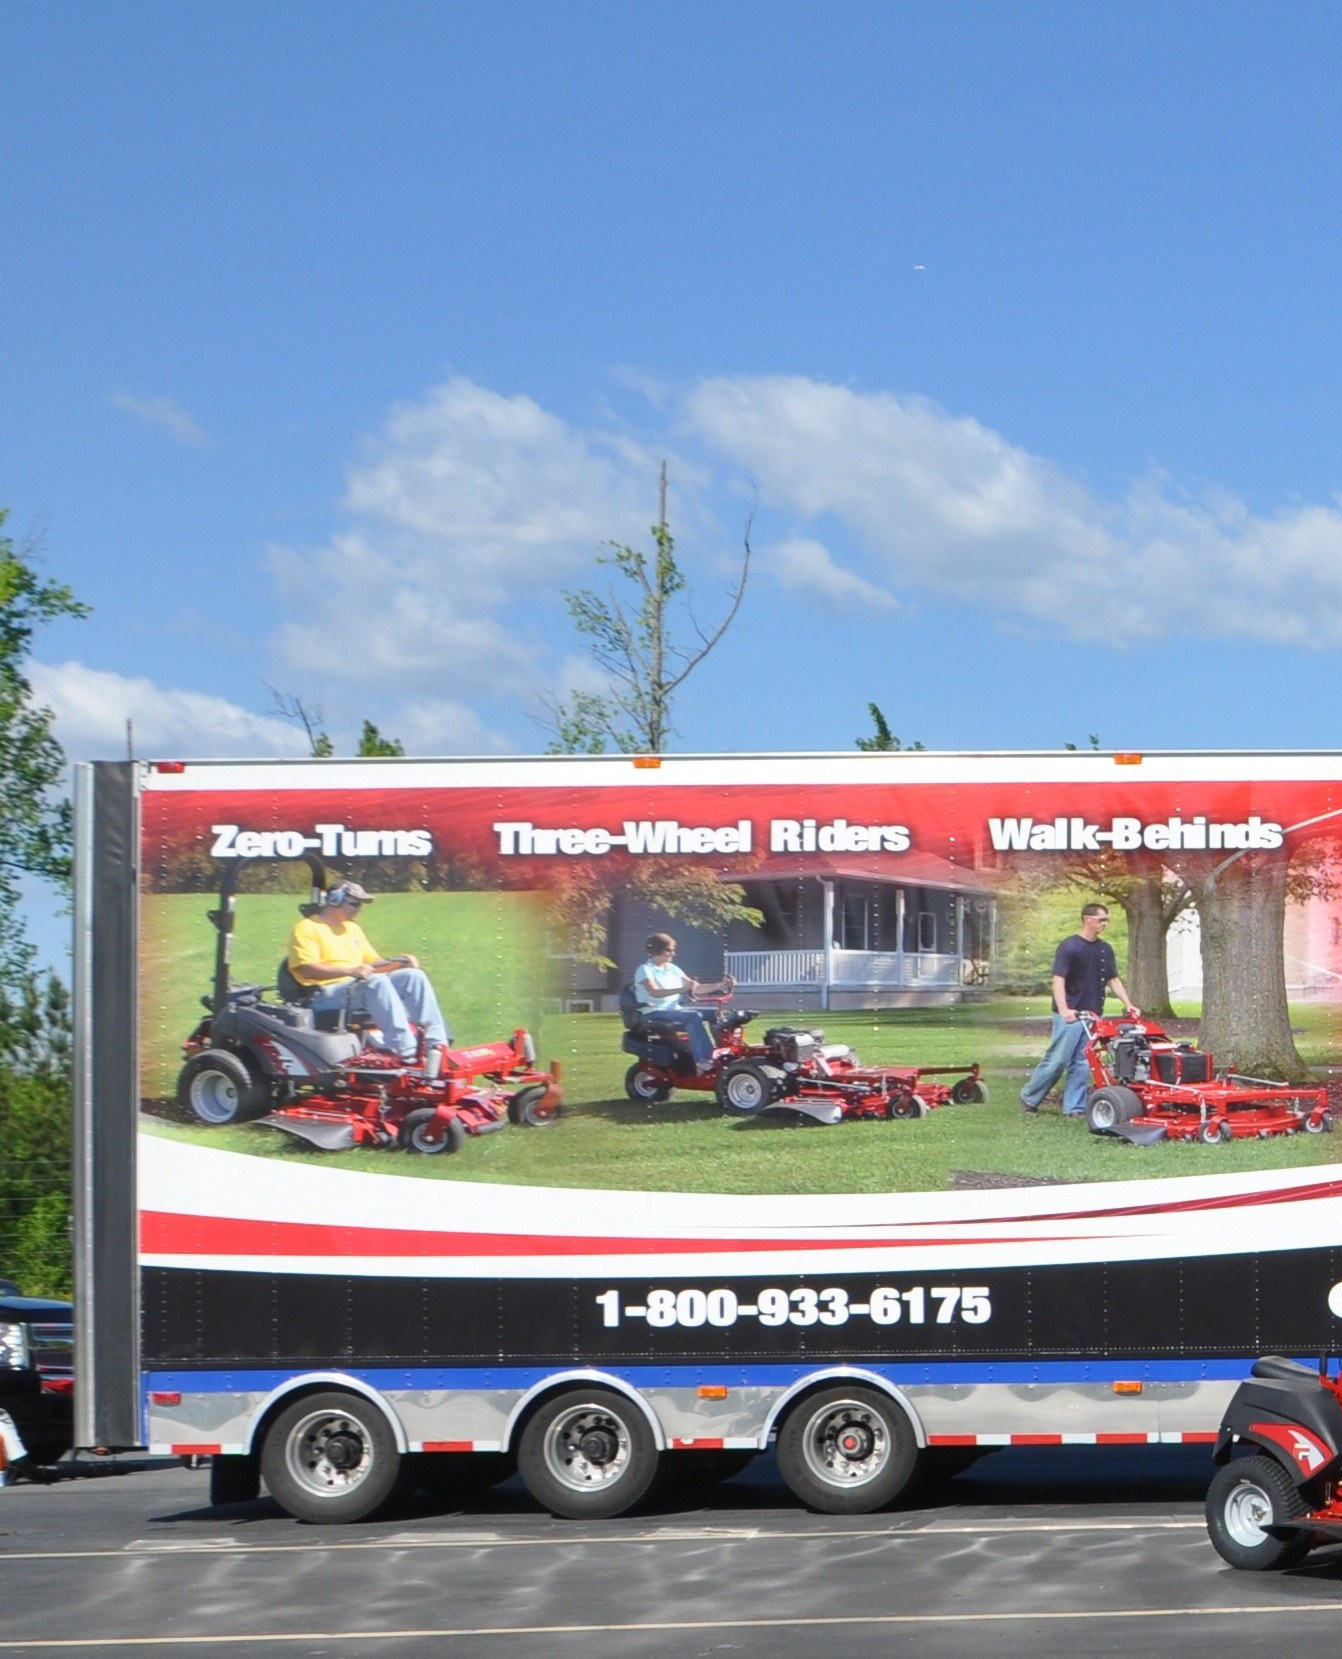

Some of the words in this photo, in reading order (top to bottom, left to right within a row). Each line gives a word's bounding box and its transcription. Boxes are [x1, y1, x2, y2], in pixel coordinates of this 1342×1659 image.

[210, 824, 433, 857] Zero-Turns
[493, 820, 752, 855] Three-Wheel
[770, 819, 911, 852] Riders
[988, 816, 1283, 851] Walk-Behinds
[595, 1286, 993, 1327] 1-800-933-6175
